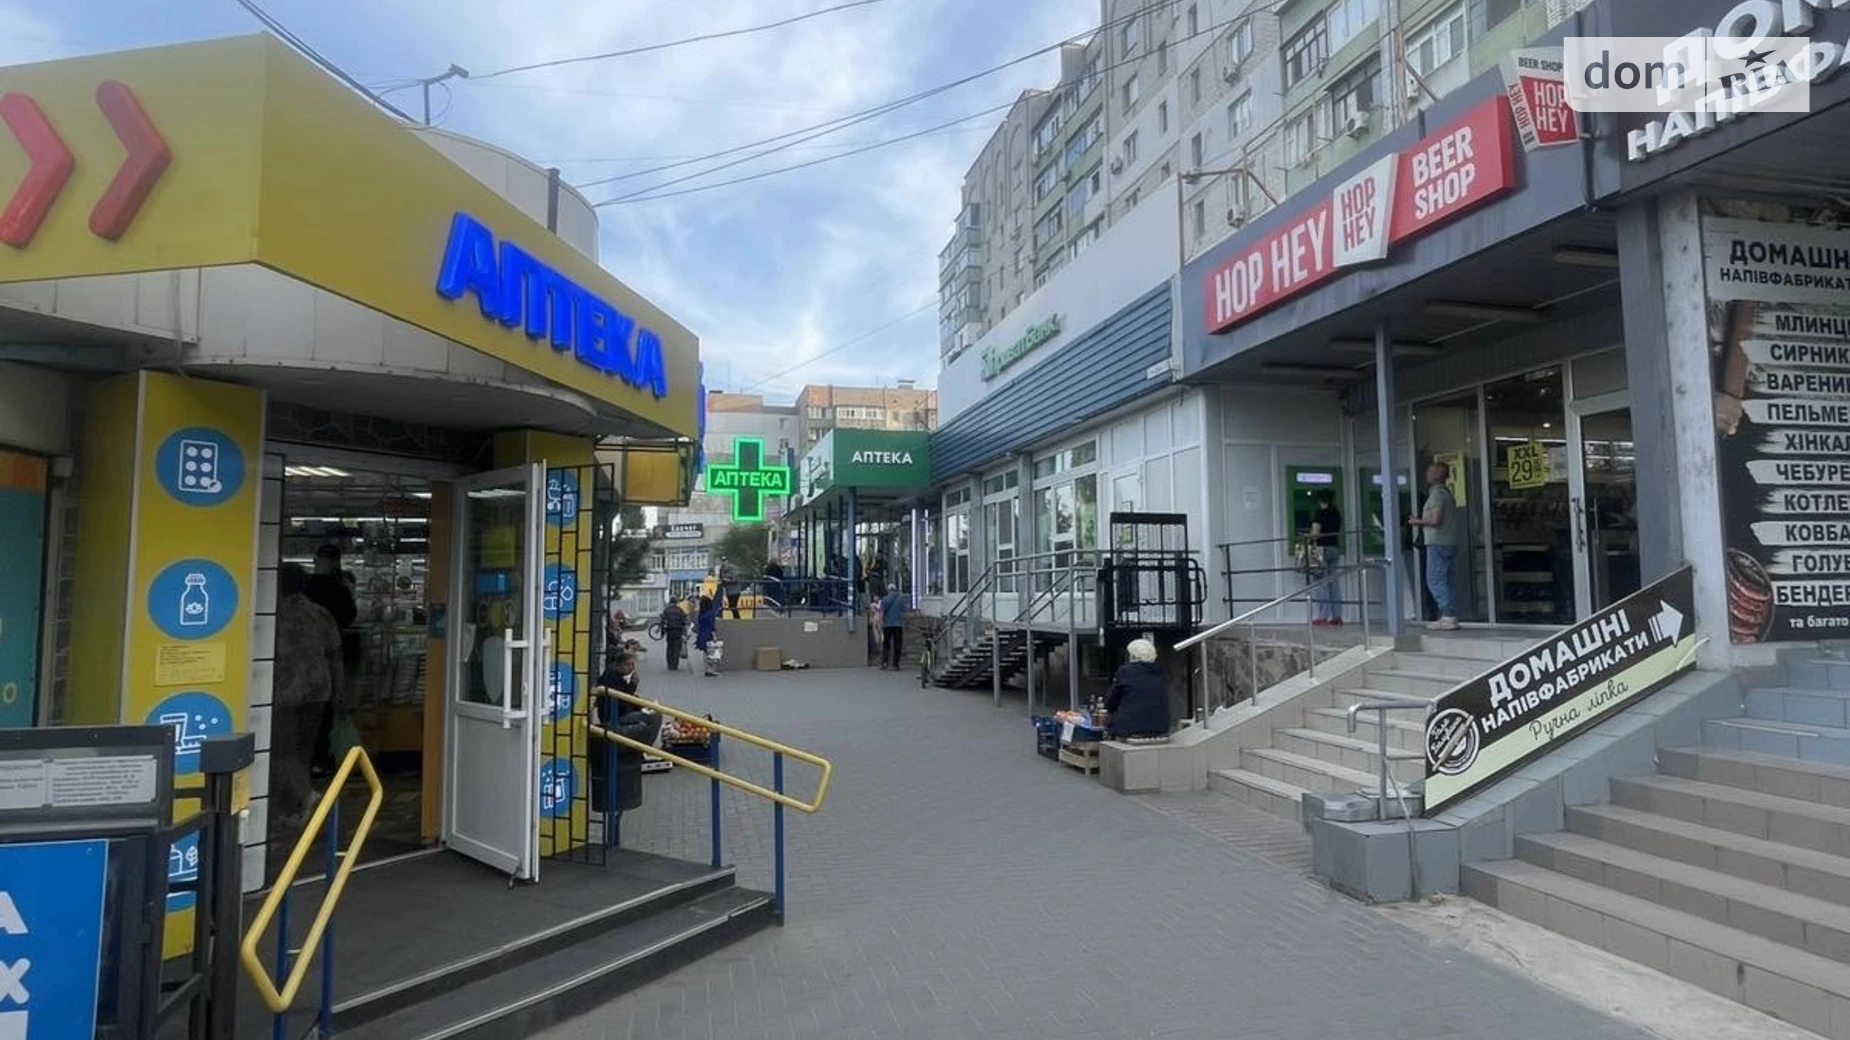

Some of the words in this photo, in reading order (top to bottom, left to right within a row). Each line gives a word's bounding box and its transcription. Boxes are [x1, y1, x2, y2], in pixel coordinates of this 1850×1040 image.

[1518, 57, 1539, 68] BEER
[1536, 106, 1568, 133] HEY
[1412, 126, 1474, 188] BEER
[1340, 176, 1376, 220] HOP
[1414, 163, 1476, 220] SHOP
[1343, 206, 1376, 252] HEY
[1215, 251, 1264, 323] HOP
[1270, 209, 1327, 293] HEY
[436, 211, 668, 399] АПТЕКА
[1775, 314, 1850, 338] МЛИНЦ
[1770, 344, 1850, 364] СИРНИК
[1766, 373, 1850, 393] ВАРЕНИ
[1767, 403, 1849, 423] ПЕЛЬМЕ
[851, 450, 913, 465] АПТЕКА
[1513, 446, 1539, 461] XXL
[714, 470, 783, 488] АПТЕКА
[1510, 459, 1533, 482] 29
[1789, 618, 1804, 628] та
[1807, 615, 1849, 628] багато
[1488, 608, 1631, 709] ДОМАШНІ
[1481, 631, 1650, 734] НАПІВФАБРИКАТИ
[1529, 706, 1581, 741] Ручна
[1586, 680, 1629, 713] ліпка
